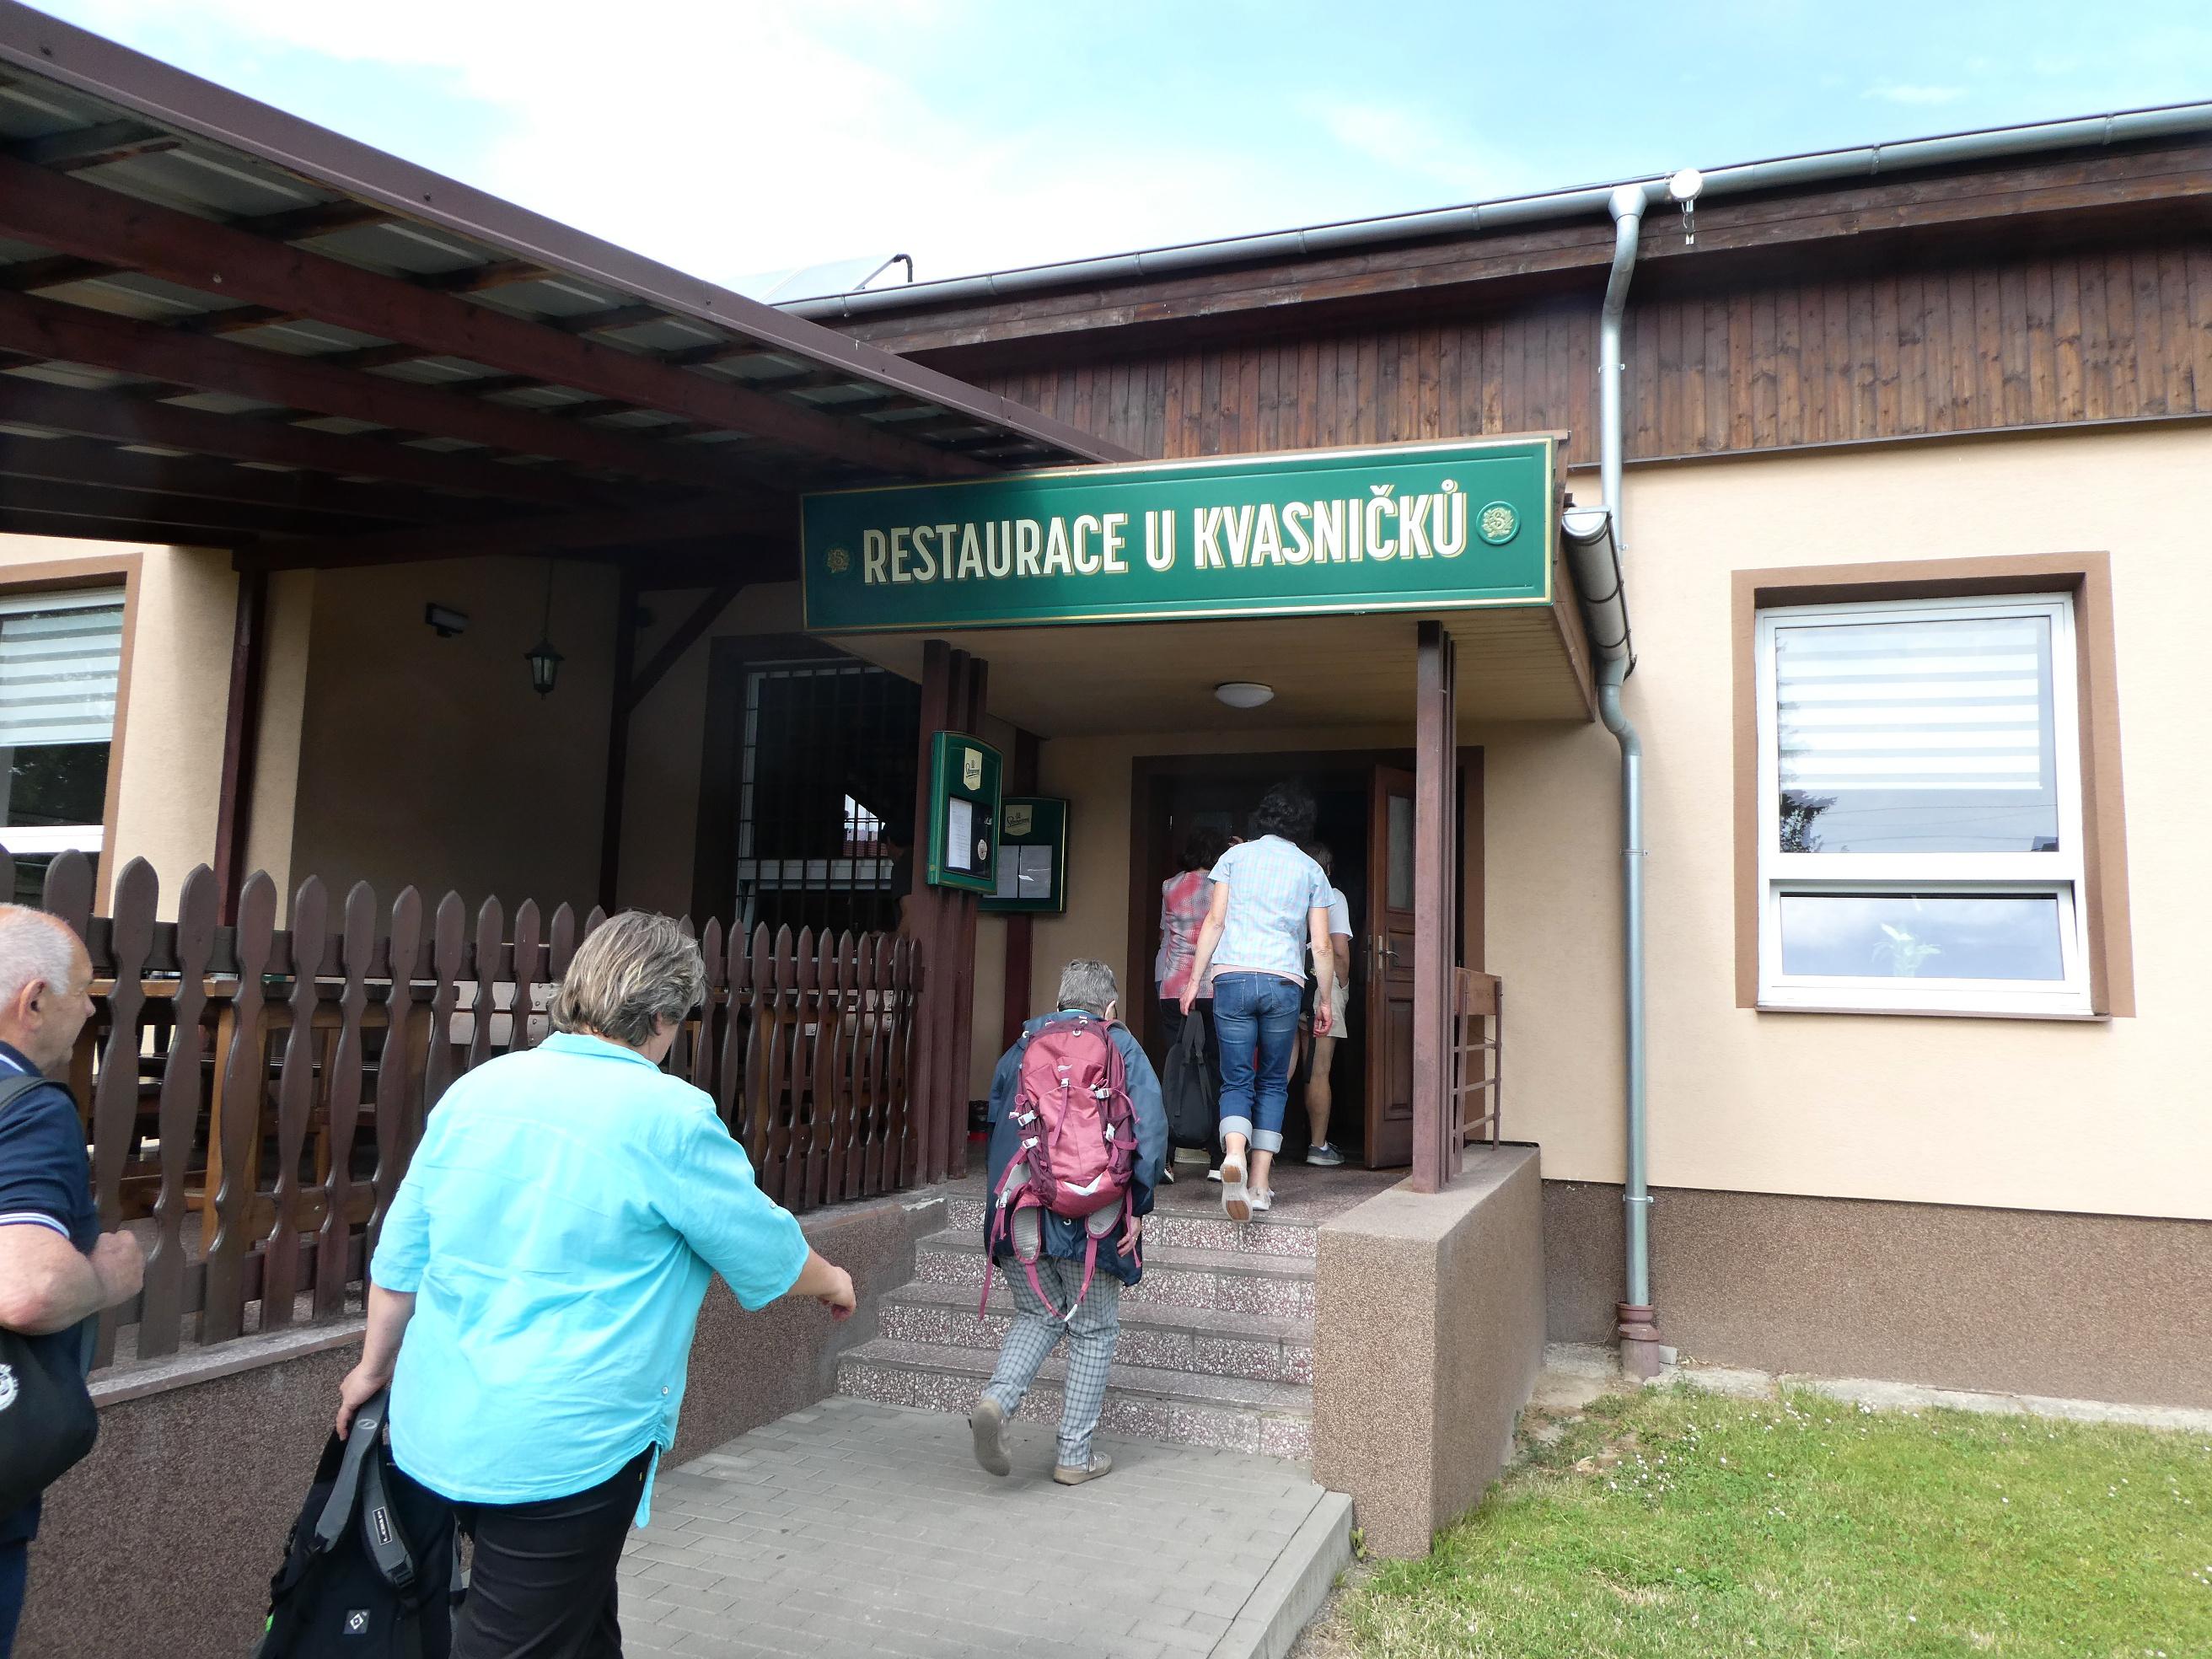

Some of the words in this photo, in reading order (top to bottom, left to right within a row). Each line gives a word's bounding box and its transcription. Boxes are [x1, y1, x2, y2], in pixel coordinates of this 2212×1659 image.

[863, 513, 1128, 584] RESTAURACE
[1146, 510, 1175, 572] U
[1194, 479, 1467, 569] KVASNIČKŮ
